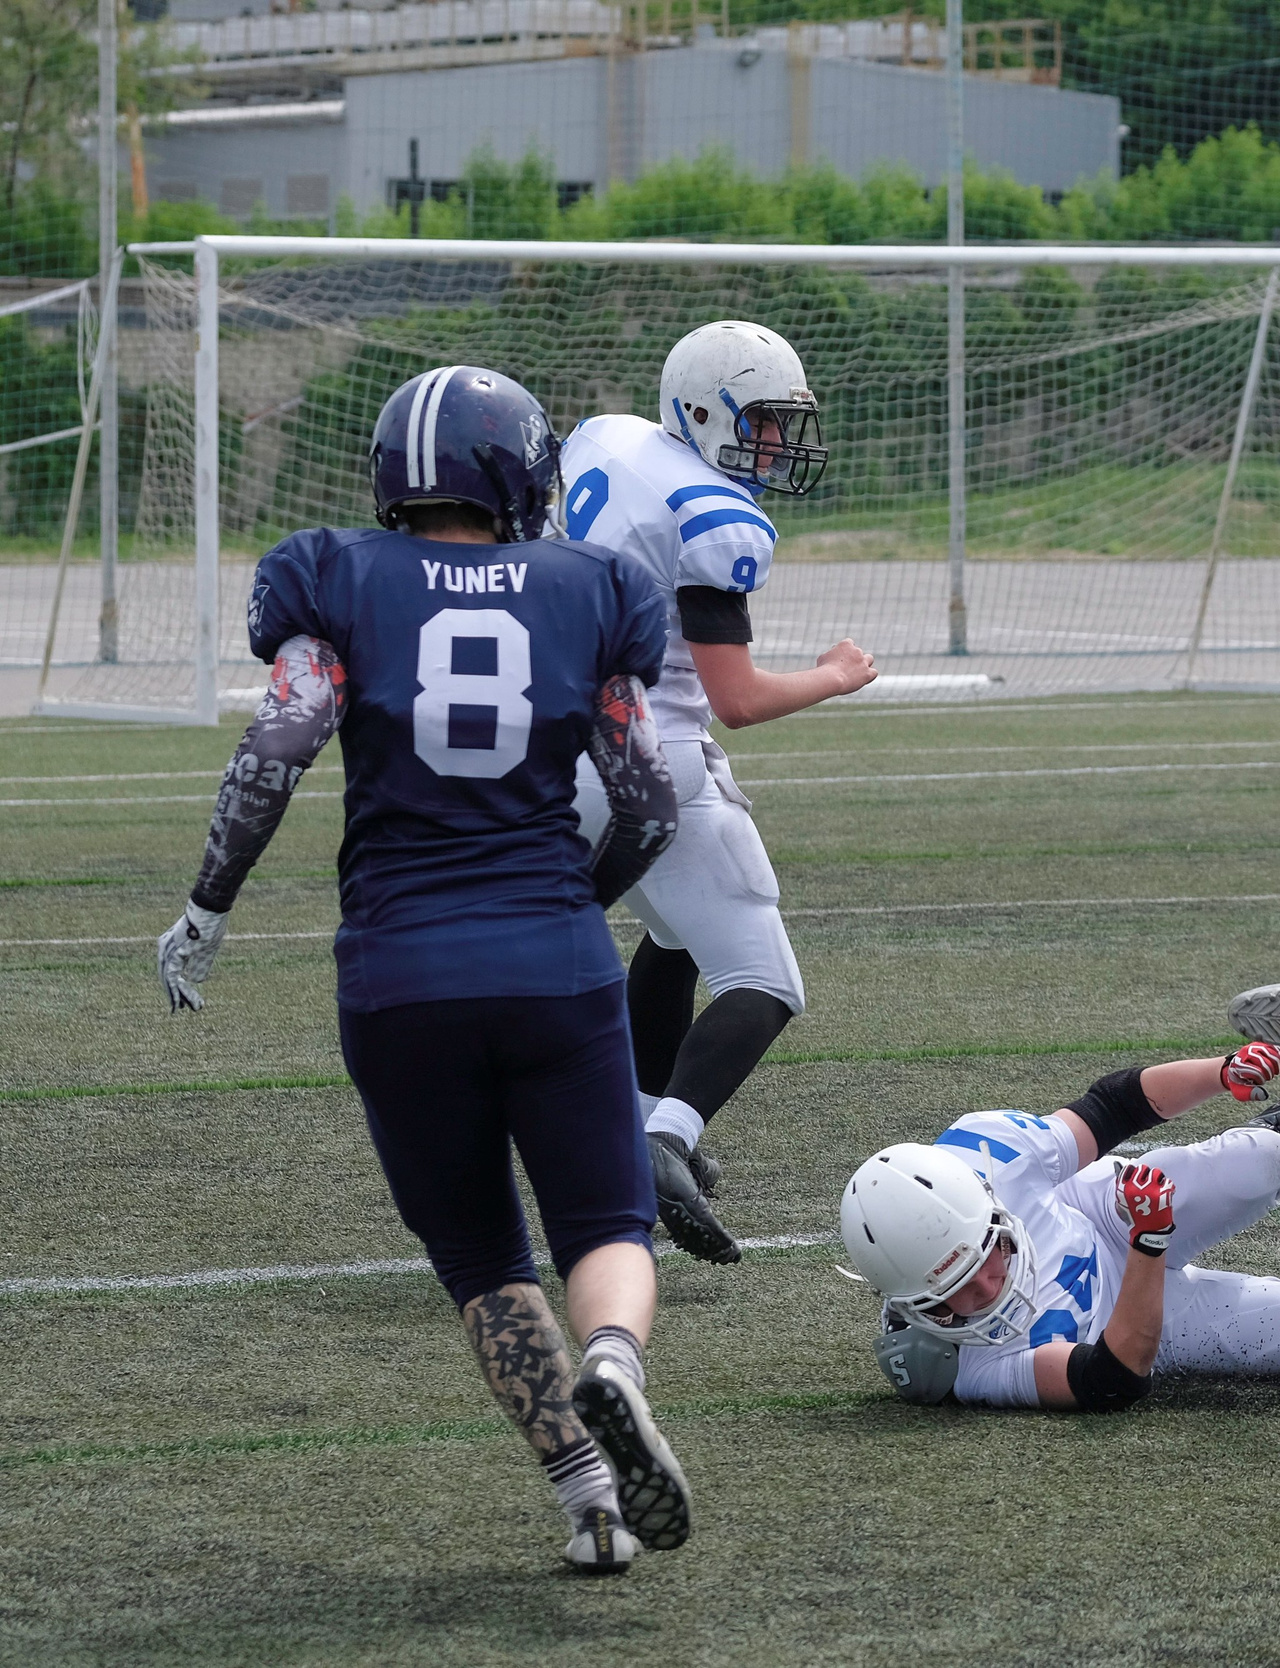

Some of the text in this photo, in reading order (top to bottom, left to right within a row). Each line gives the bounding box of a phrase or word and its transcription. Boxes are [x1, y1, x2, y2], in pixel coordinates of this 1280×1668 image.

[421, 558, 528, 593] YUNEV
[727, 556, 758, 593] 9
[413, 608, 533, 778] 8
